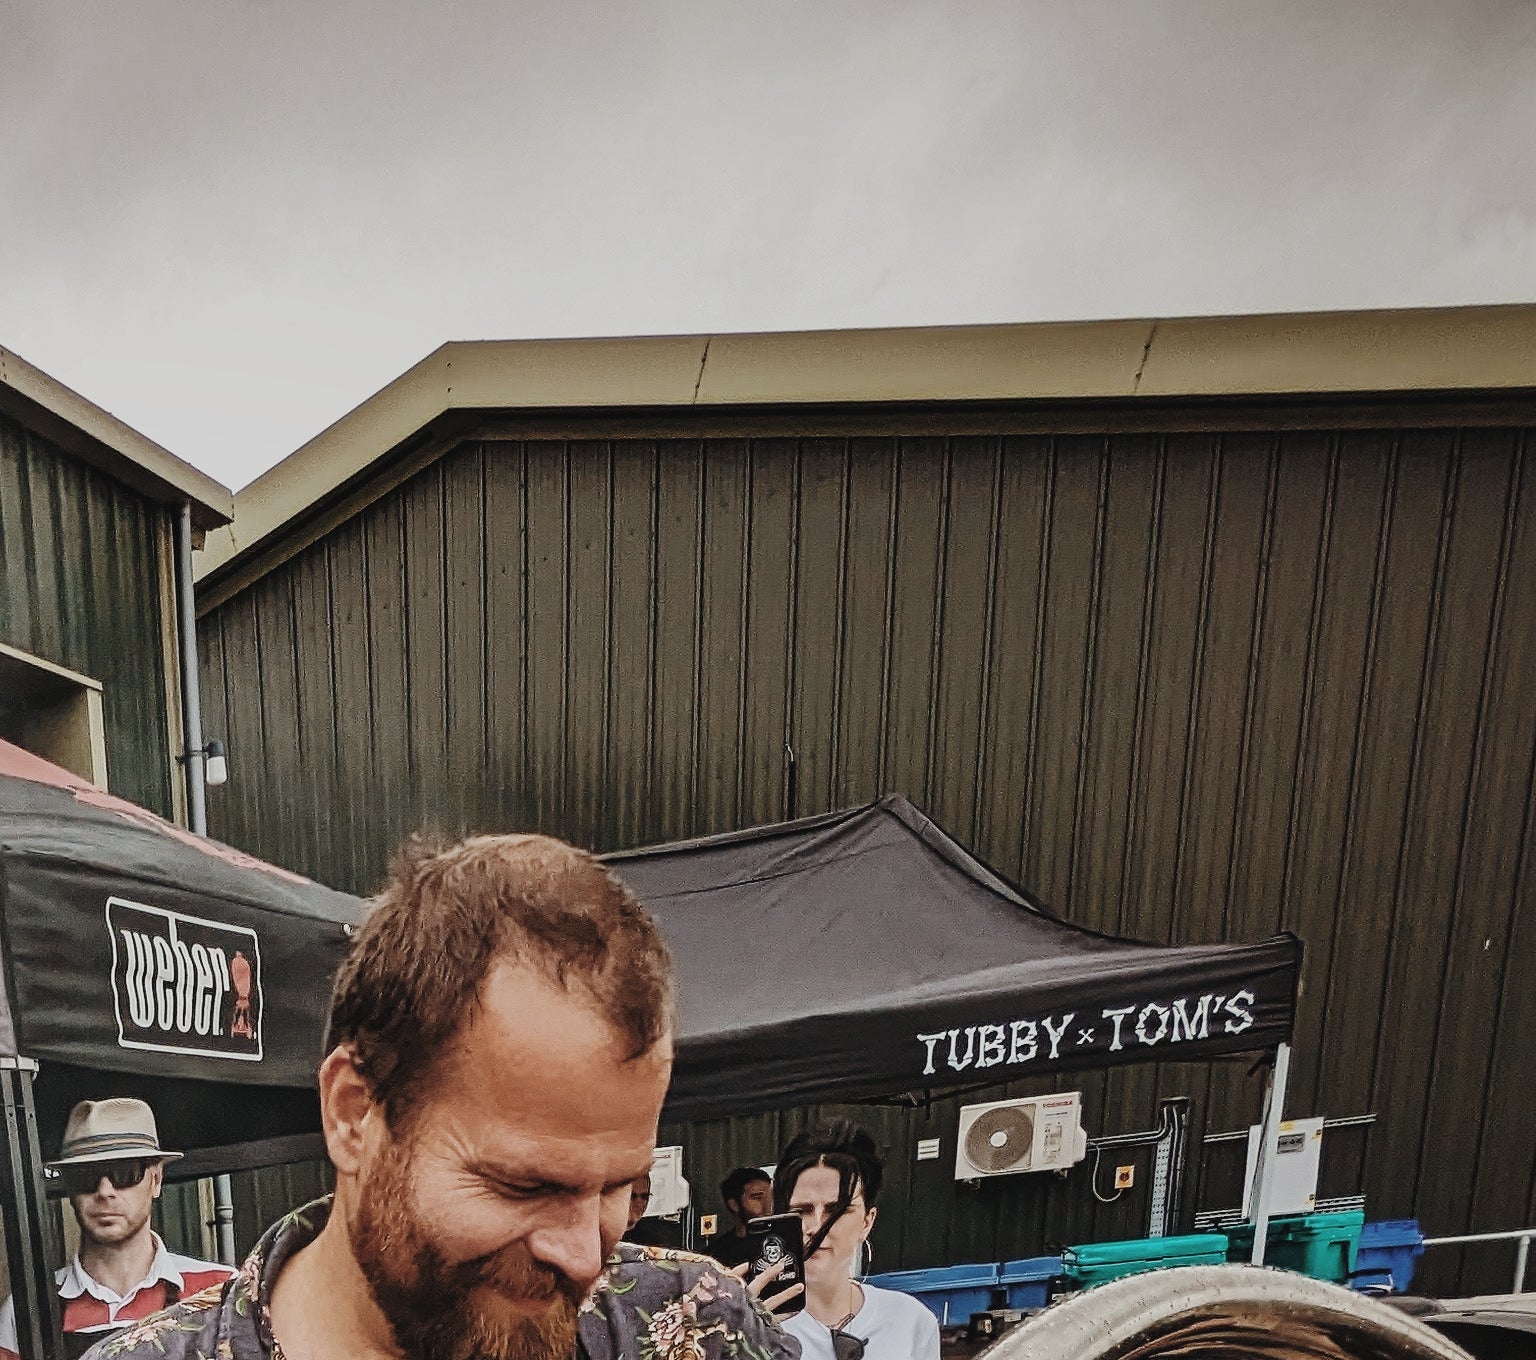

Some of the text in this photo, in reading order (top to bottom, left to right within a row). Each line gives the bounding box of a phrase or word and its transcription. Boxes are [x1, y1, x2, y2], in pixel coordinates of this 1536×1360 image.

[120, 915, 230, 1036] weber
[917, 1013, 1076, 1075] TUBBY
[1102, 990, 1256, 1051] TOM'S
